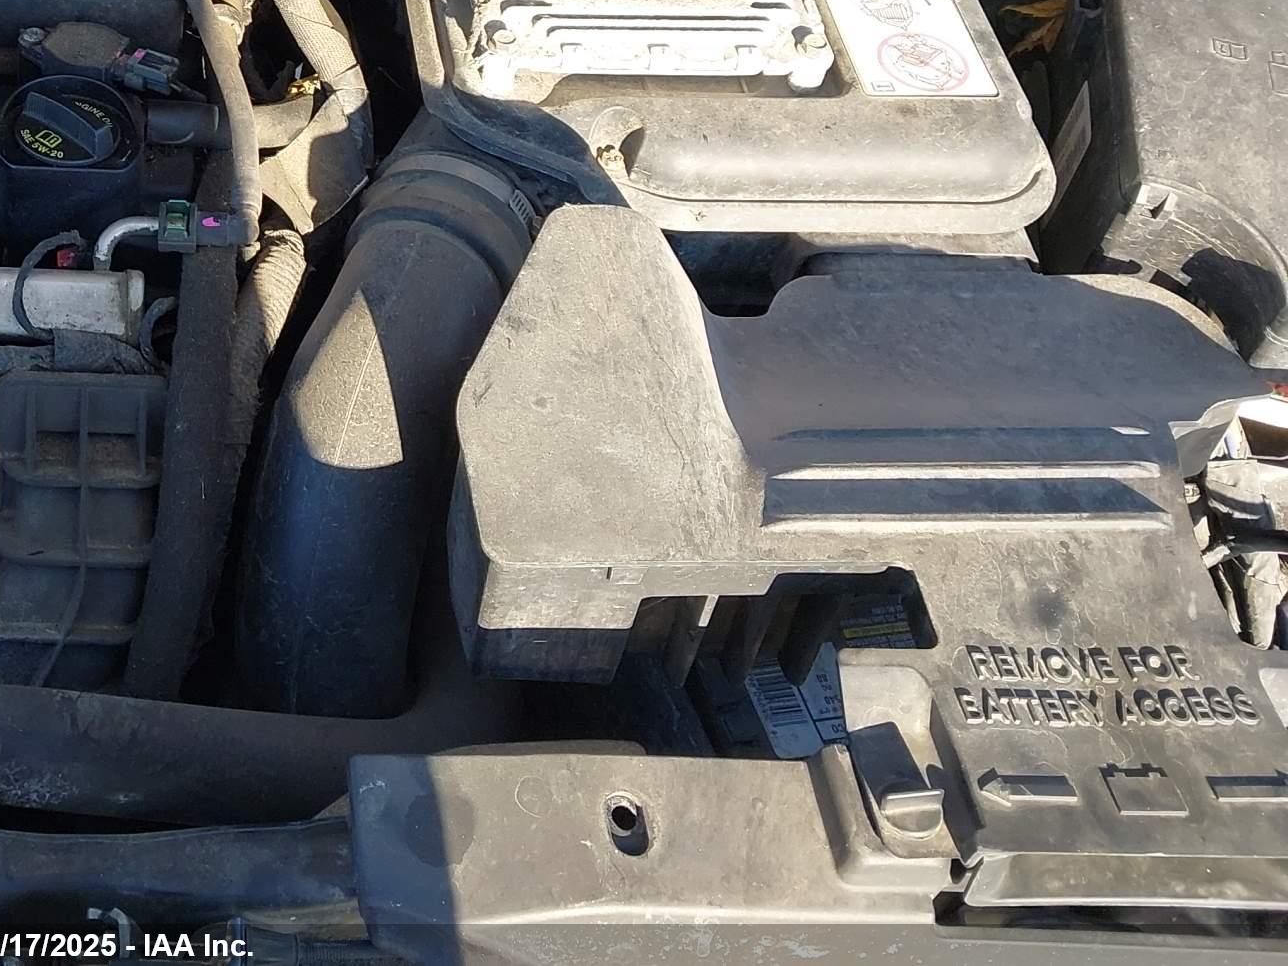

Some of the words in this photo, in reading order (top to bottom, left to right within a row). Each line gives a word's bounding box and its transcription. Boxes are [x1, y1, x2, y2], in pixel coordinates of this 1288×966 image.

[20, 129, 35, 143] SAE
[32, 142, 64, 158] 5W-20
[966, 645, 1119, 683] REMOVE
[1118, 645, 1200, 682] FOR
[954, 687, 1104, 726] BATTERY
[1115, 686, 1263, 726] ACCESS
